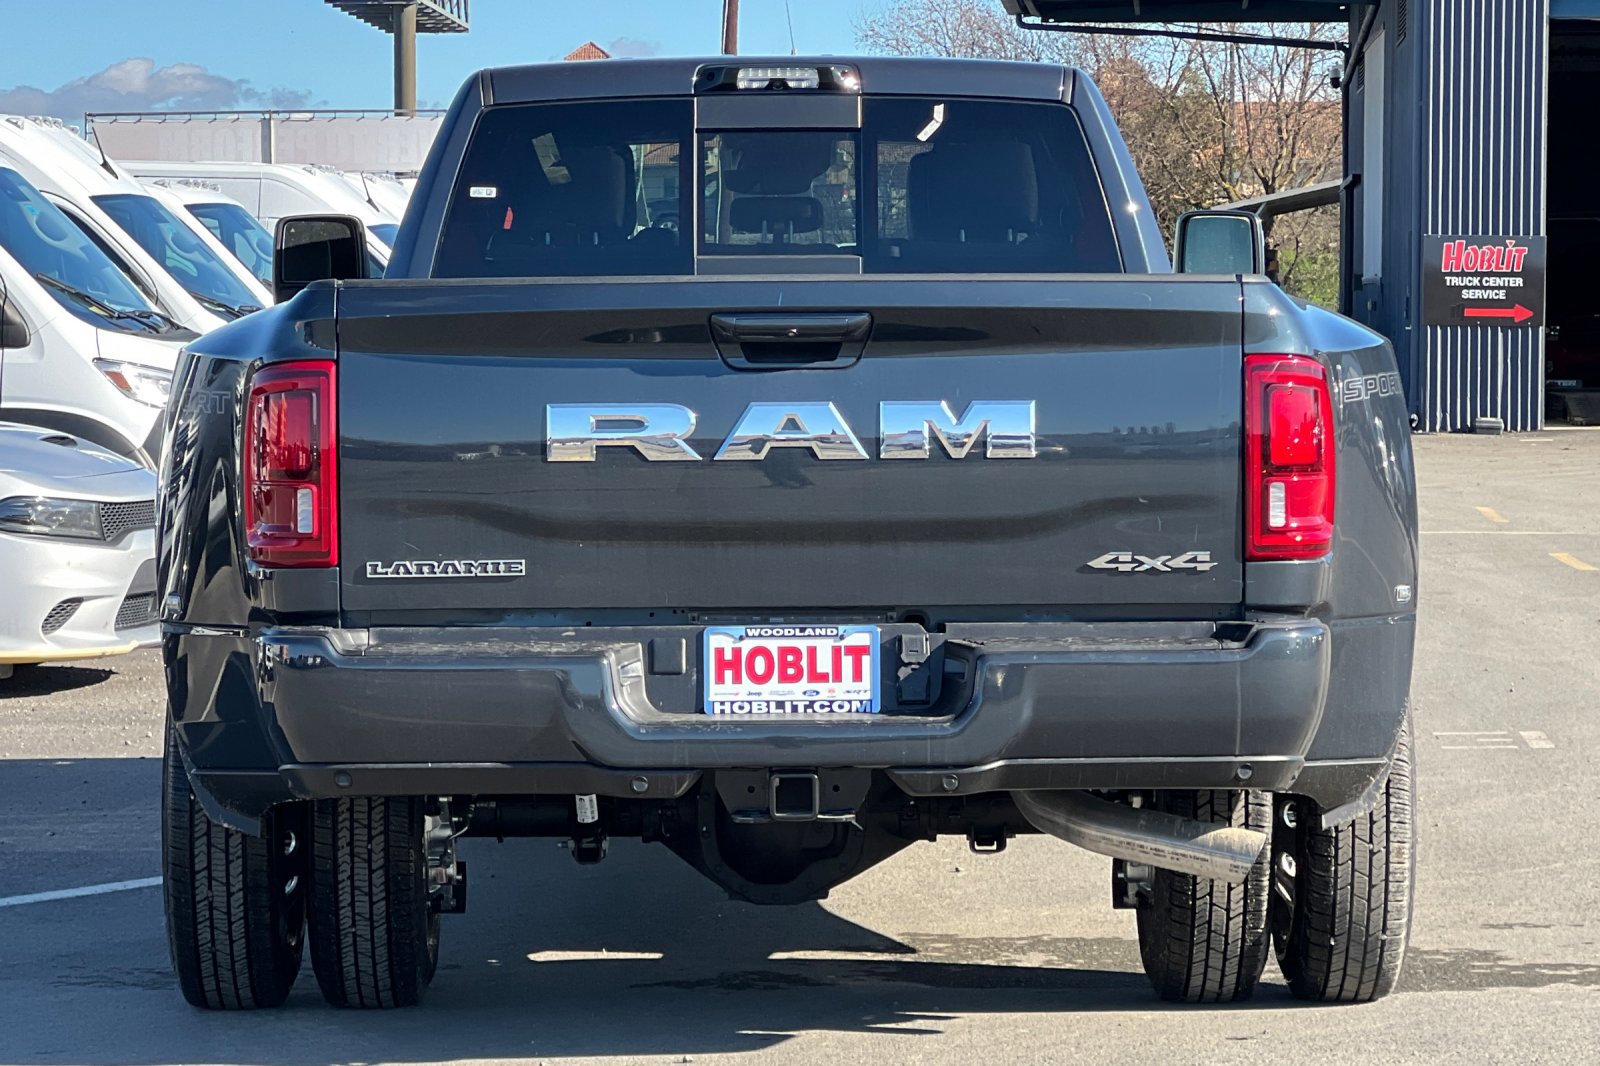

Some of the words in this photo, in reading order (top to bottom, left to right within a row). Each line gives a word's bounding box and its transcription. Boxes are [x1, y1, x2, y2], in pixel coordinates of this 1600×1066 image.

[1441, 240, 1528, 272] HOBLIT
[1445, 276, 1481, 287] TRUCK
[1482, 277, 1523, 287] CENTER
[1461, 289, 1506, 299] SERVICE
[546, 400, 1036, 462] RAM
[366, 559, 526, 578] LARAMIE
[1087, 551, 1218, 571] 4x4
[746, 627, 838, 637] WOODLAND
[714, 645, 871, 685] HOBLIT
[713, 700, 872, 714] HOBLIT.COM
